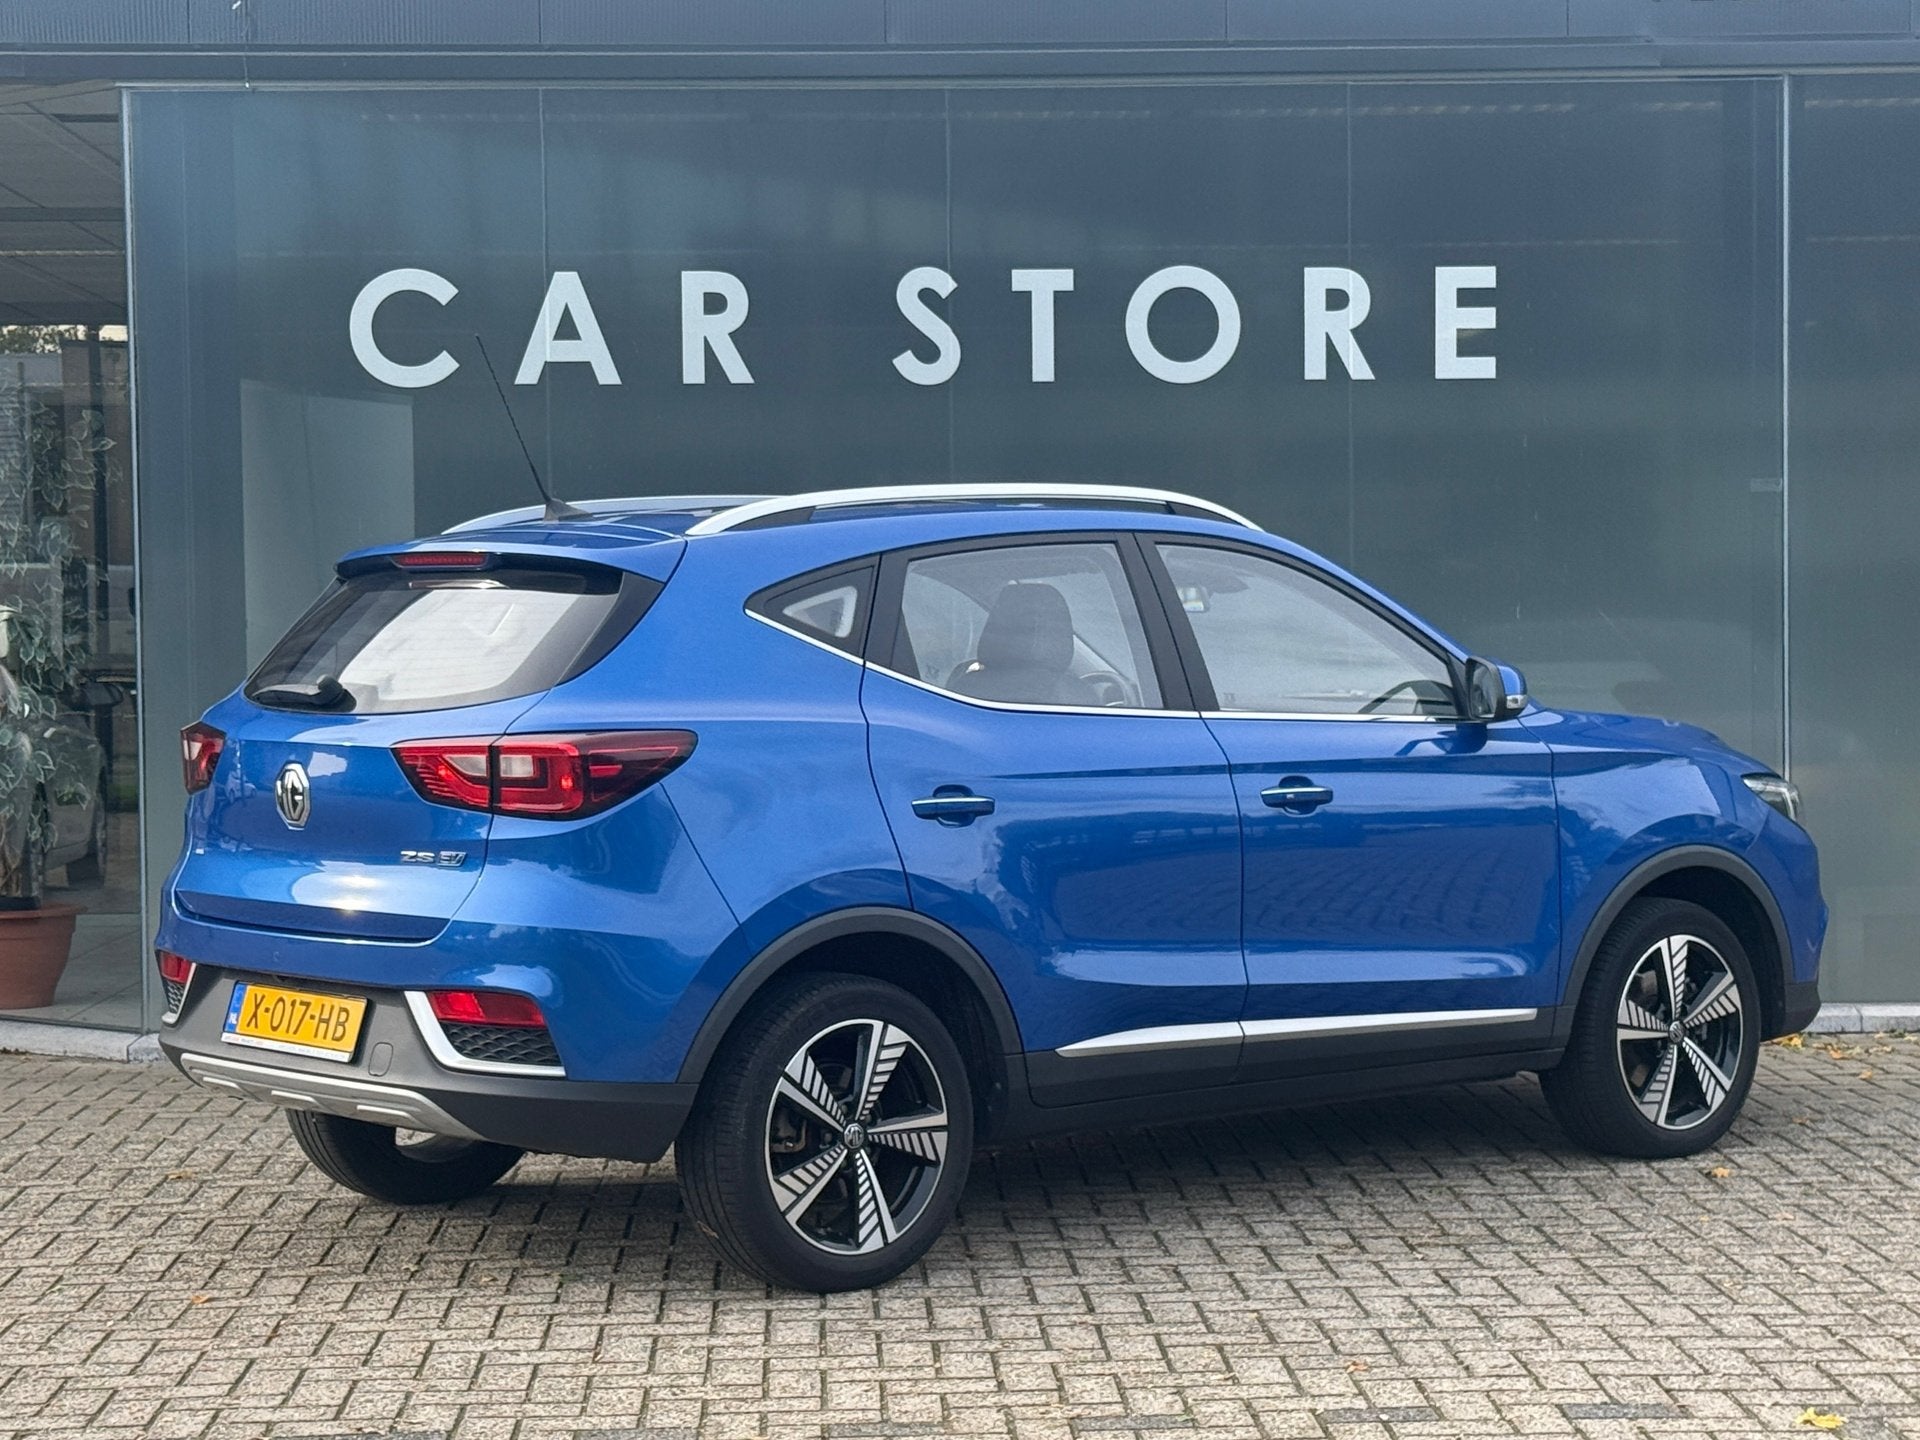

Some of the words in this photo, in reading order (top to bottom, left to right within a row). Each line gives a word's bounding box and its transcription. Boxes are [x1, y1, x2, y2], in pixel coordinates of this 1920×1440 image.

[349, 268, 755, 388] CAR
[892, 265, 1498, 384] STORE
[400, 850, 436, 863] ZS
[246, 993, 350, 1042] X-017-HB
